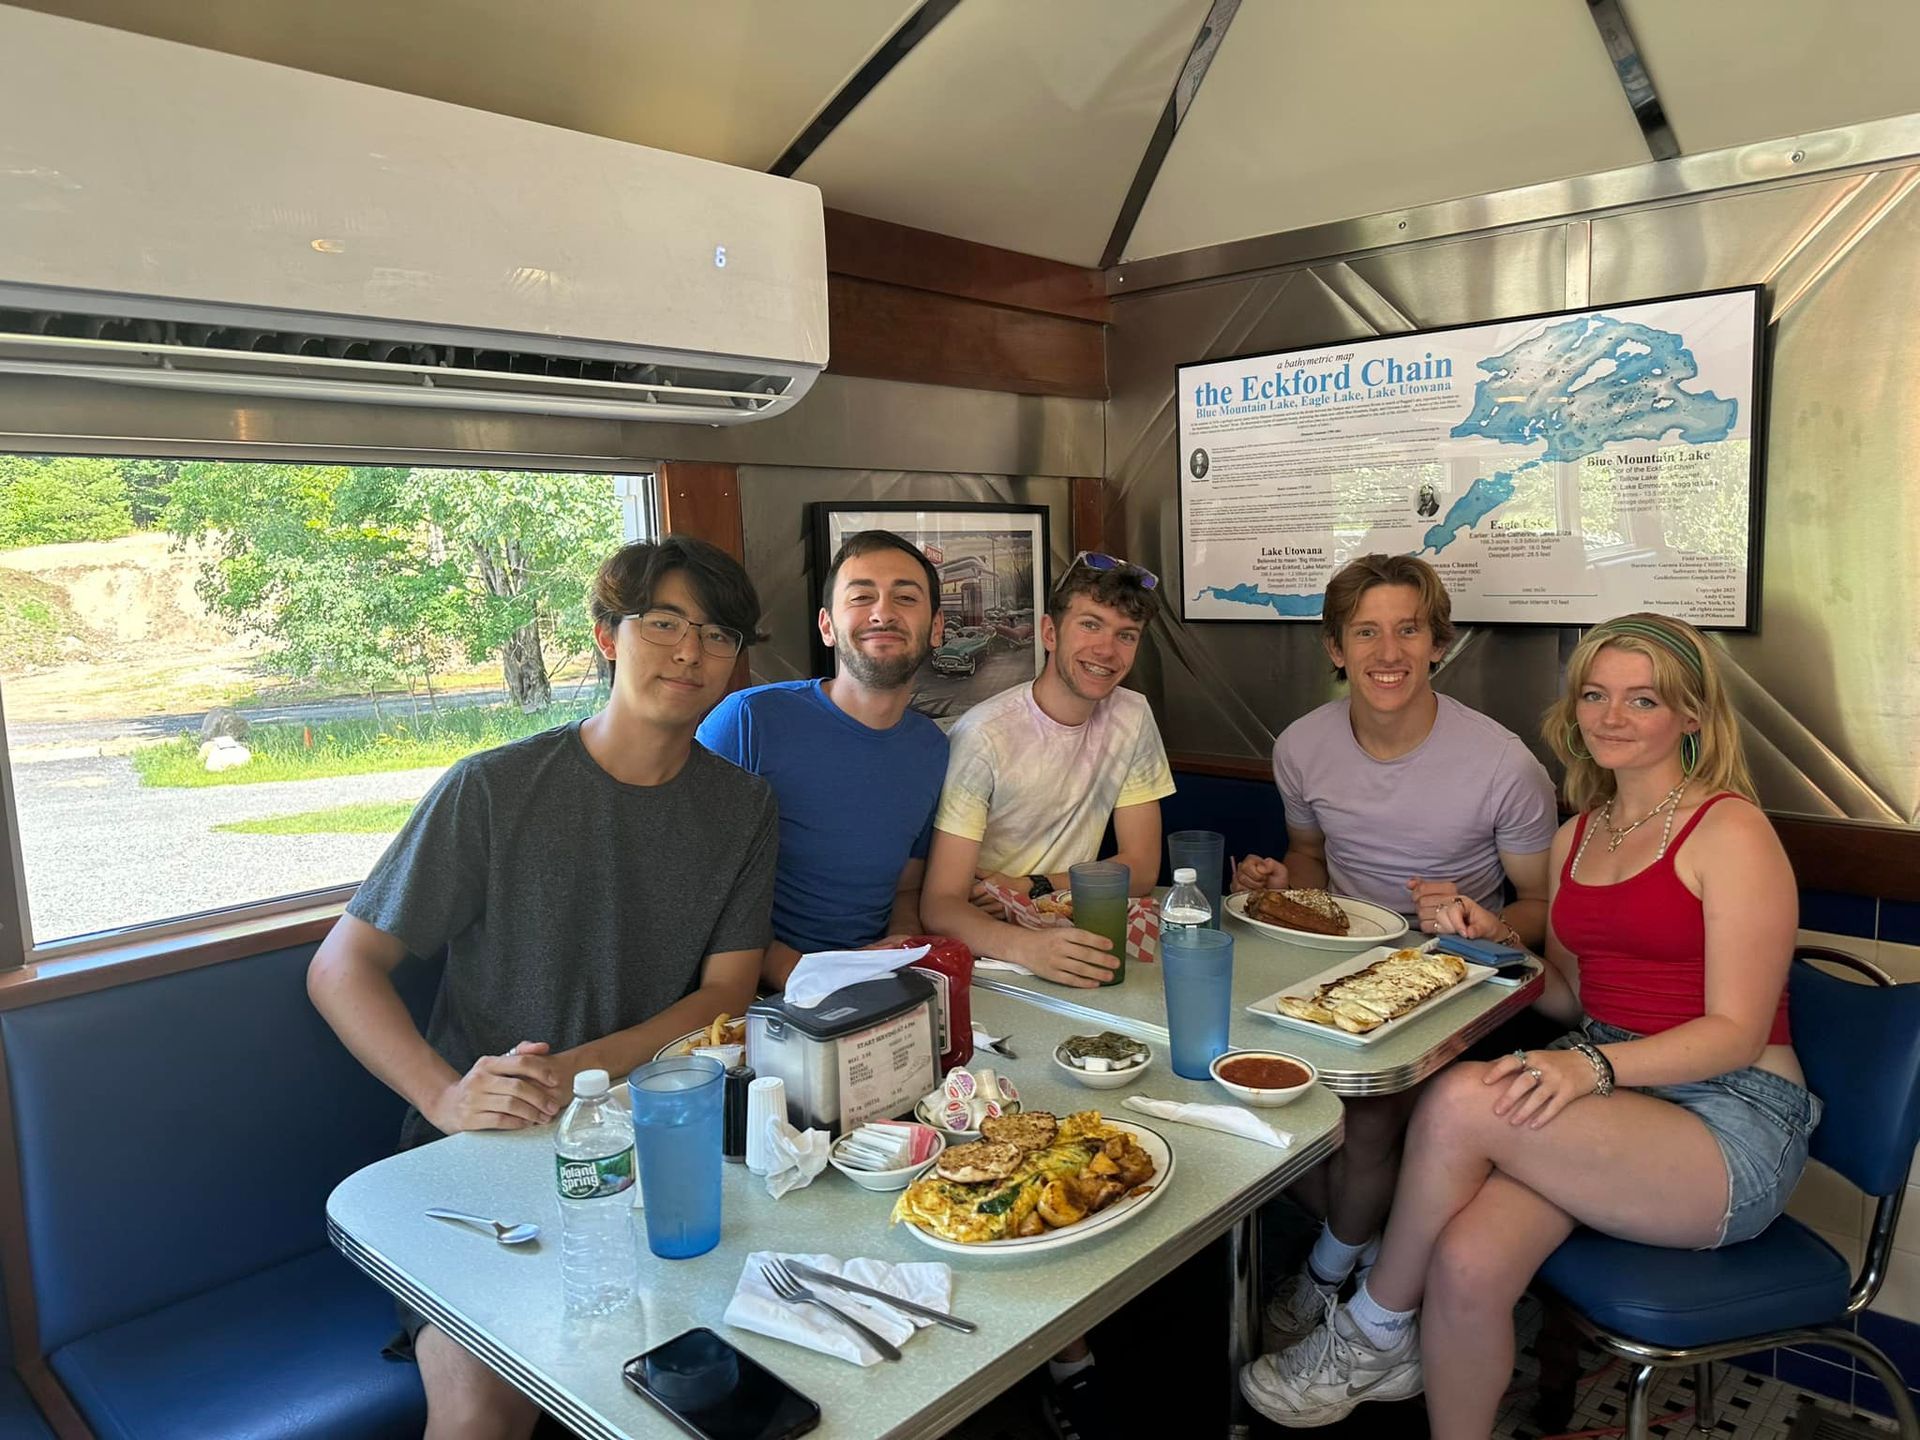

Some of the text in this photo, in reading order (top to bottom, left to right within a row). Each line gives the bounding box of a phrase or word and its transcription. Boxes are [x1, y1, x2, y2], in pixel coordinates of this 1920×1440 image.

[715, 245, 726, 268] 6
[1284, 354, 1334, 368] bathymetric
[1335, 352, 1355, 362] map
[1194, 352, 1453, 408] the Eckford Chain
[1196, 381, 1452, 419] Blue Mountain Lake, Eagle Lake, Lake Utowana
[1587, 450, 1711, 467] Blue Mountain Lake
[1490, 520, 1520, 530] Eagle
[1261, 546, 1323, 556] Lake Utowana
[857, 1037, 876, 1050] START
[560, 1162, 597, 1180] Poland
[561, 1175, 599, 1193] Spring
